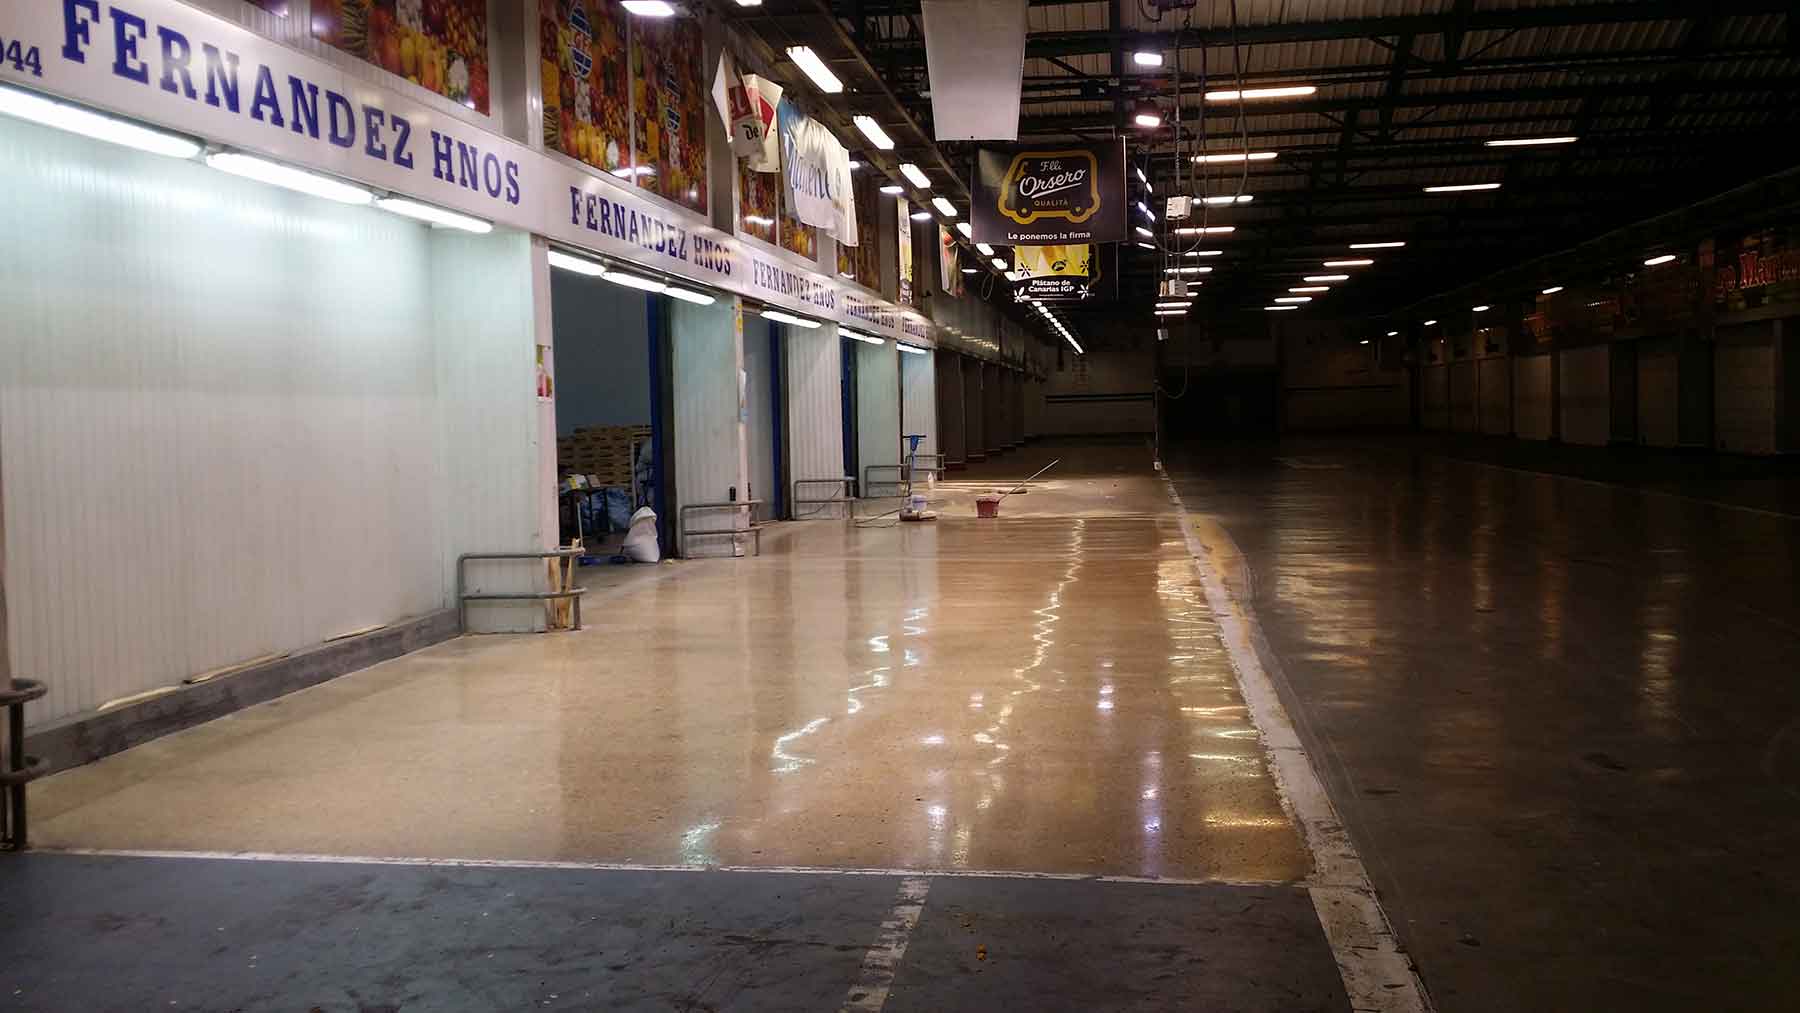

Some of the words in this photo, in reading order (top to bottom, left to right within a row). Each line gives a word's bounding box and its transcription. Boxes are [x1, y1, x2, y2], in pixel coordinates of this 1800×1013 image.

[61, 0, 415, 169] FERNANDEZ
[430, 130, 521, 205] HNOS
[1019, 169, 1087, 197] Orsero
[569, 185, 688, 261] FERNANDEZ
[693, 234, 732, 276] HNOS
[1007, 232, 1018, 240] Le
[1019, 232, 1058, 241] ponemos
[1059, 231, 1067, 240] la
[1069, 231, 1091, 239] firma
[752, 258, 811, 302] FERNANDEZ
[812, 281, 835, 310] HNOS
